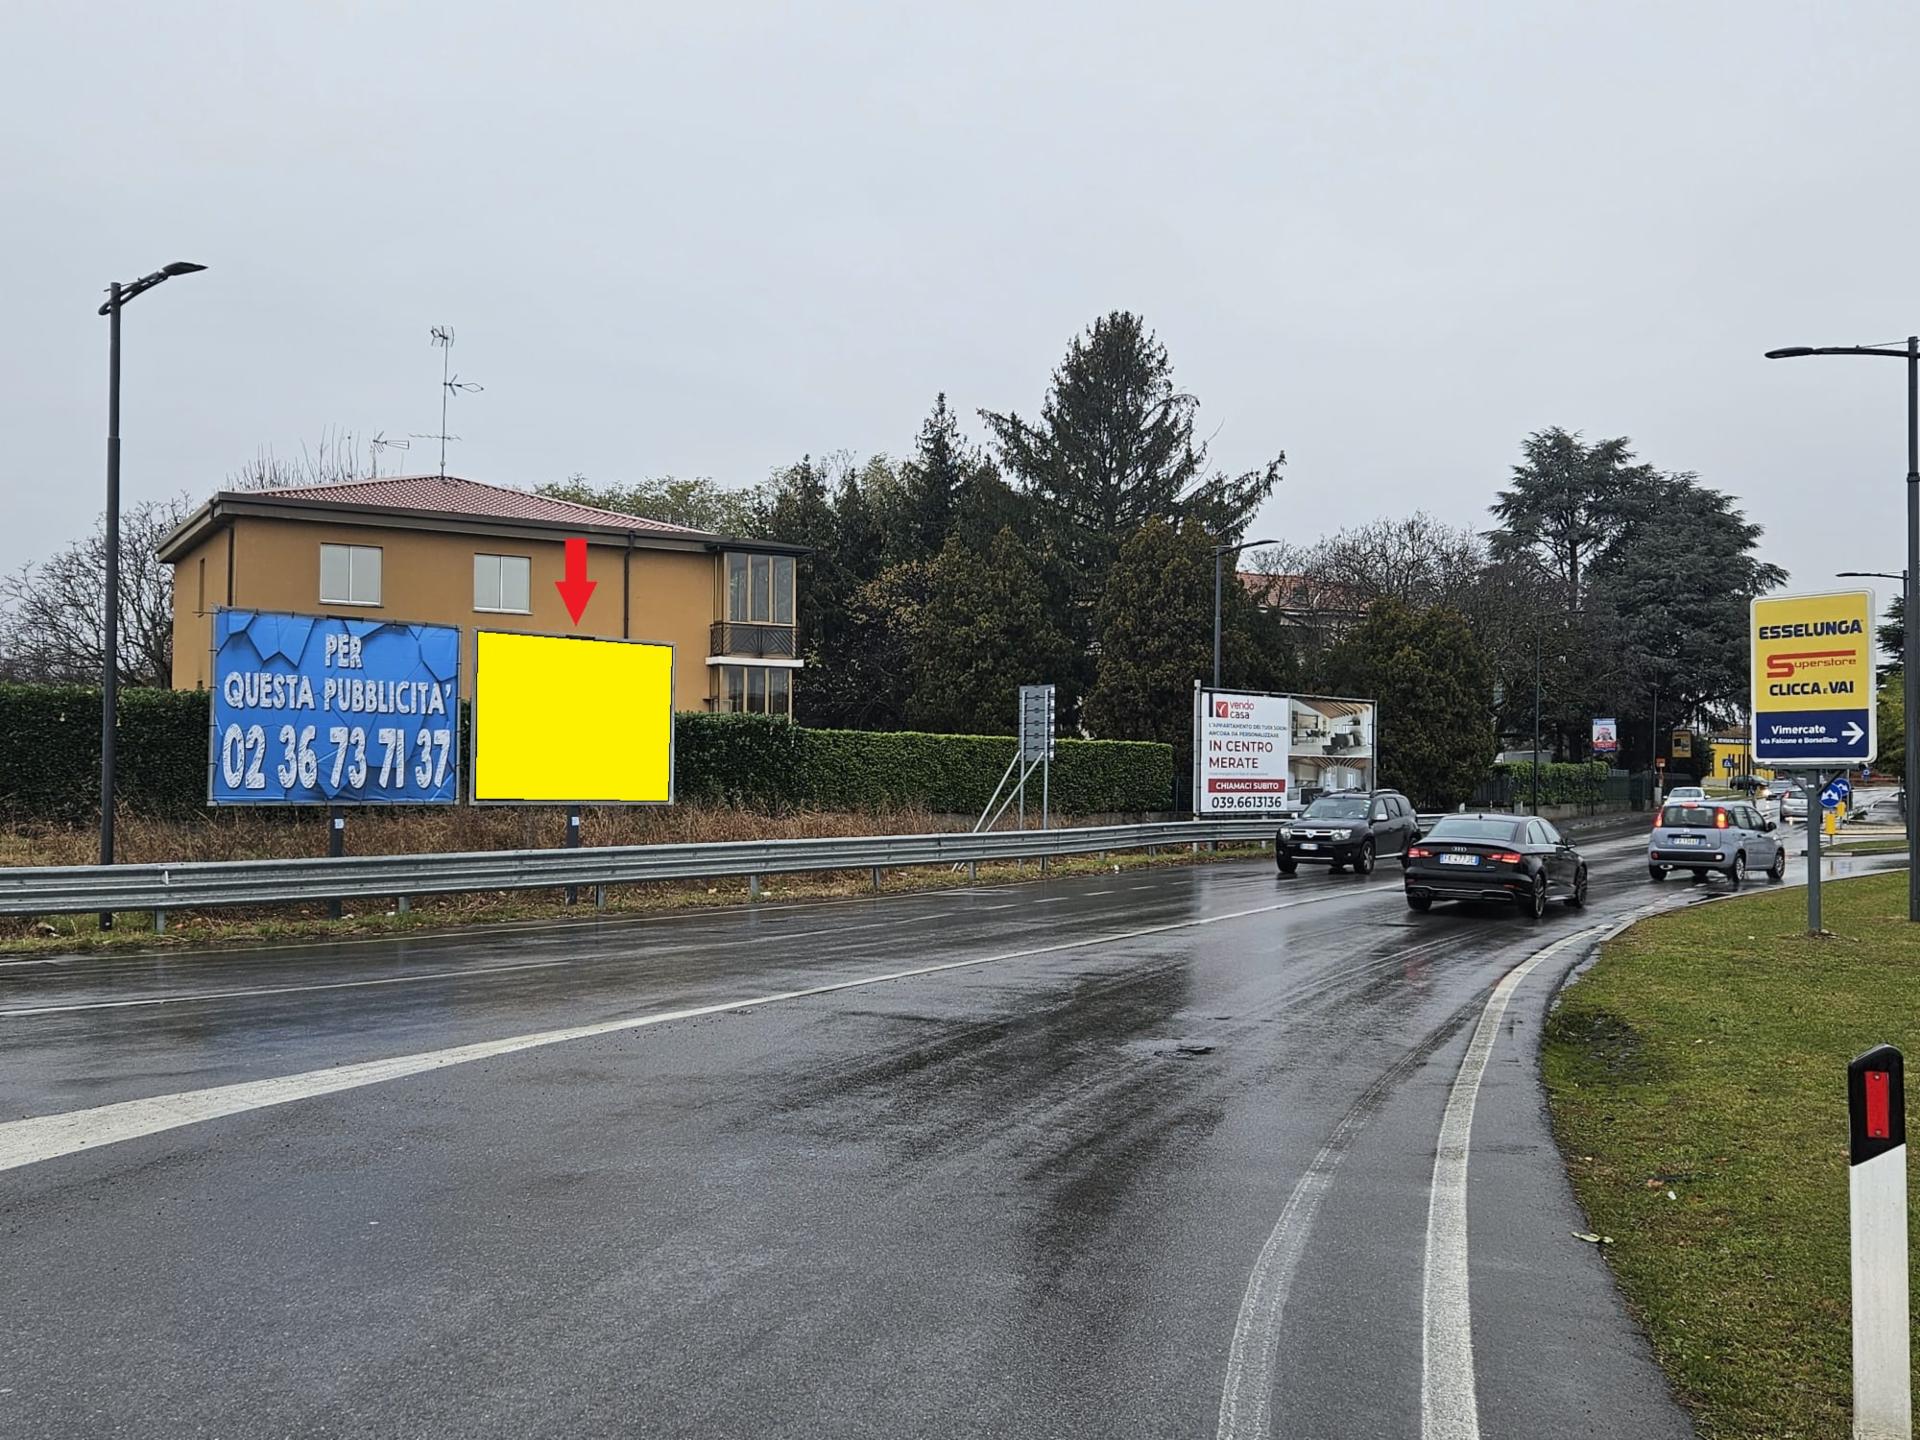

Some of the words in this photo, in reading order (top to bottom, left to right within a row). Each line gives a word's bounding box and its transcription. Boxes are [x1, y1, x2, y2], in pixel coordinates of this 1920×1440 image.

[1759, 619, 1863, 640] ESSELUNGA
[325, 633, 363, 669] PER
[1767, 649, 1857, 679] Superstore
[223, 670, 315, 711] QUESTA
[323, 677, 452, 716] PUBBLICITA'
[1769, 682, 1821, 697] CLICCA
[1829, 681, 1854, 694] VAI
[1230, 699, 1255, 711] vendo
[1230, 711, 1250, 720] casa
[1771, 725, 1826, 735] Vimercate
[1209, 740, 1222, 752] IN
[1226, 740, 1273, 753] CENTRO
[1804, 736, 1838, 744] Borsellino
[222, 722, 266, 790] 02
[278, 724, 318, 790] 36
[329, 725, 368, 789] 73
[378, 727, 405, 789] 71
[415, 728, 451, 789] 37
[1209, 757, 1259, 769] MERATE
[1215, 782, 1252, 791] CHIAMACI
[1253, 782, 1279, 790] SUBITO
[1211, 796, 1282, 809] 039.6613136
